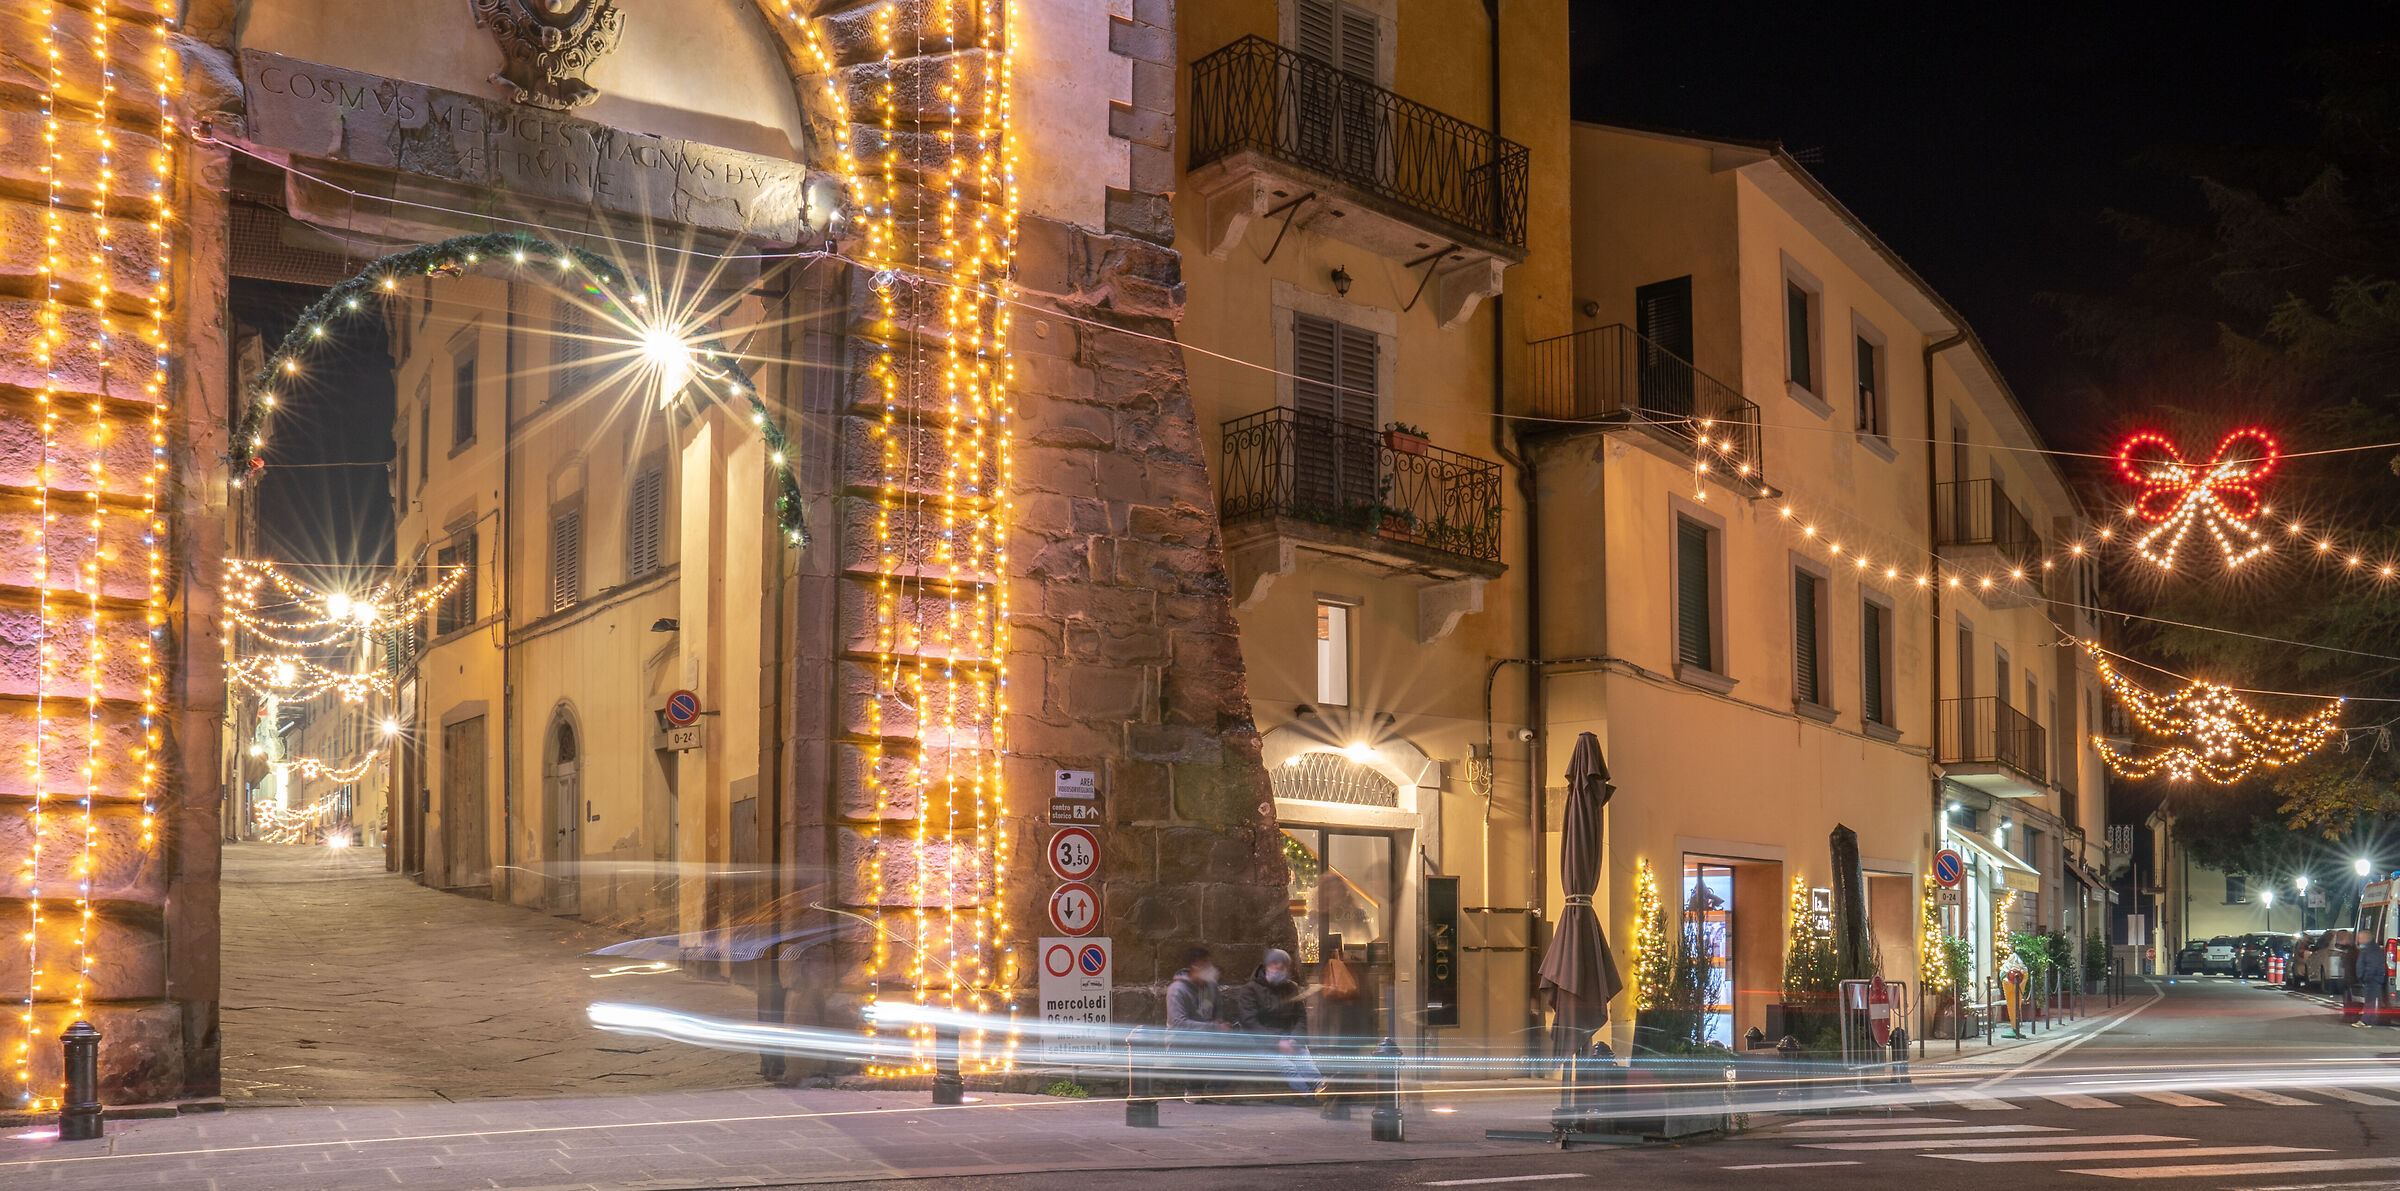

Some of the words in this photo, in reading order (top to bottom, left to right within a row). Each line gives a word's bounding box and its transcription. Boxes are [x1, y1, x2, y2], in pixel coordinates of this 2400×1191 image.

[260, 66, 416, 120] COSMVS
[587, 128, 715, 180] MAGNVS
[1080, 777, 1094, 786] AREA
[1052, 812, 1072, 820] storico
[1942, 892, 1957, 902] 0-24
[1435, 923, 1449, 981] OPEN
[1083, 1013, 1106, 1024] 15.00
